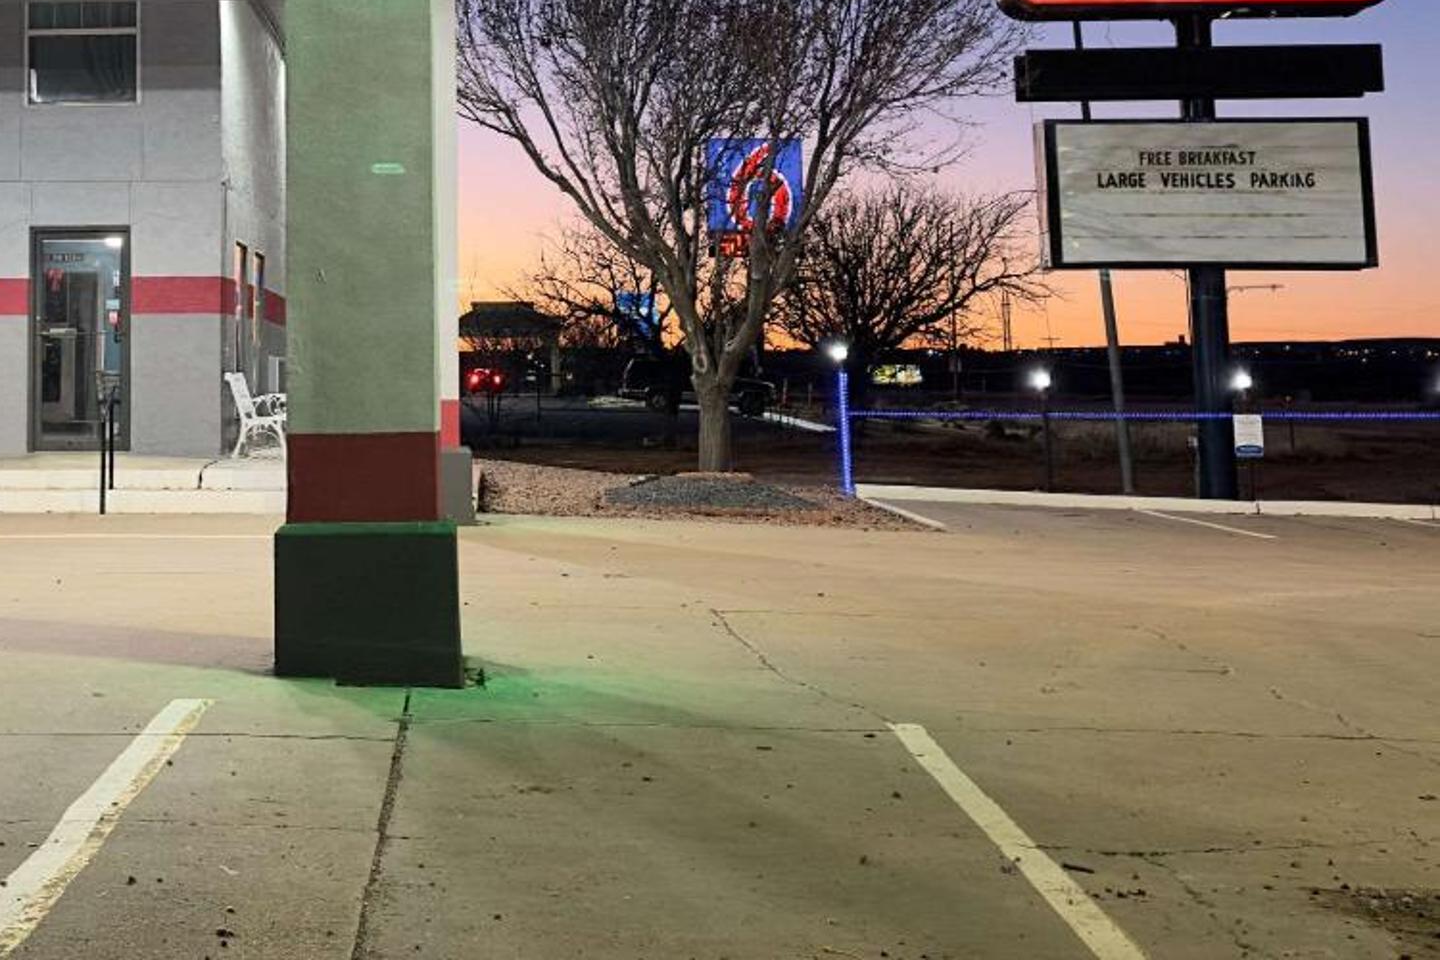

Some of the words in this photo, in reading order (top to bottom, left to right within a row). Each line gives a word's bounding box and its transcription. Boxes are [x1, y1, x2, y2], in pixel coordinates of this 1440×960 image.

[1139, 151, 1172, 166] FREE
[1178, 151, 1256, 166] BREAKFAST
[1097, 172, 1147, 189] LARGE
[1160, 172, 1236, 189] VEHICLES
